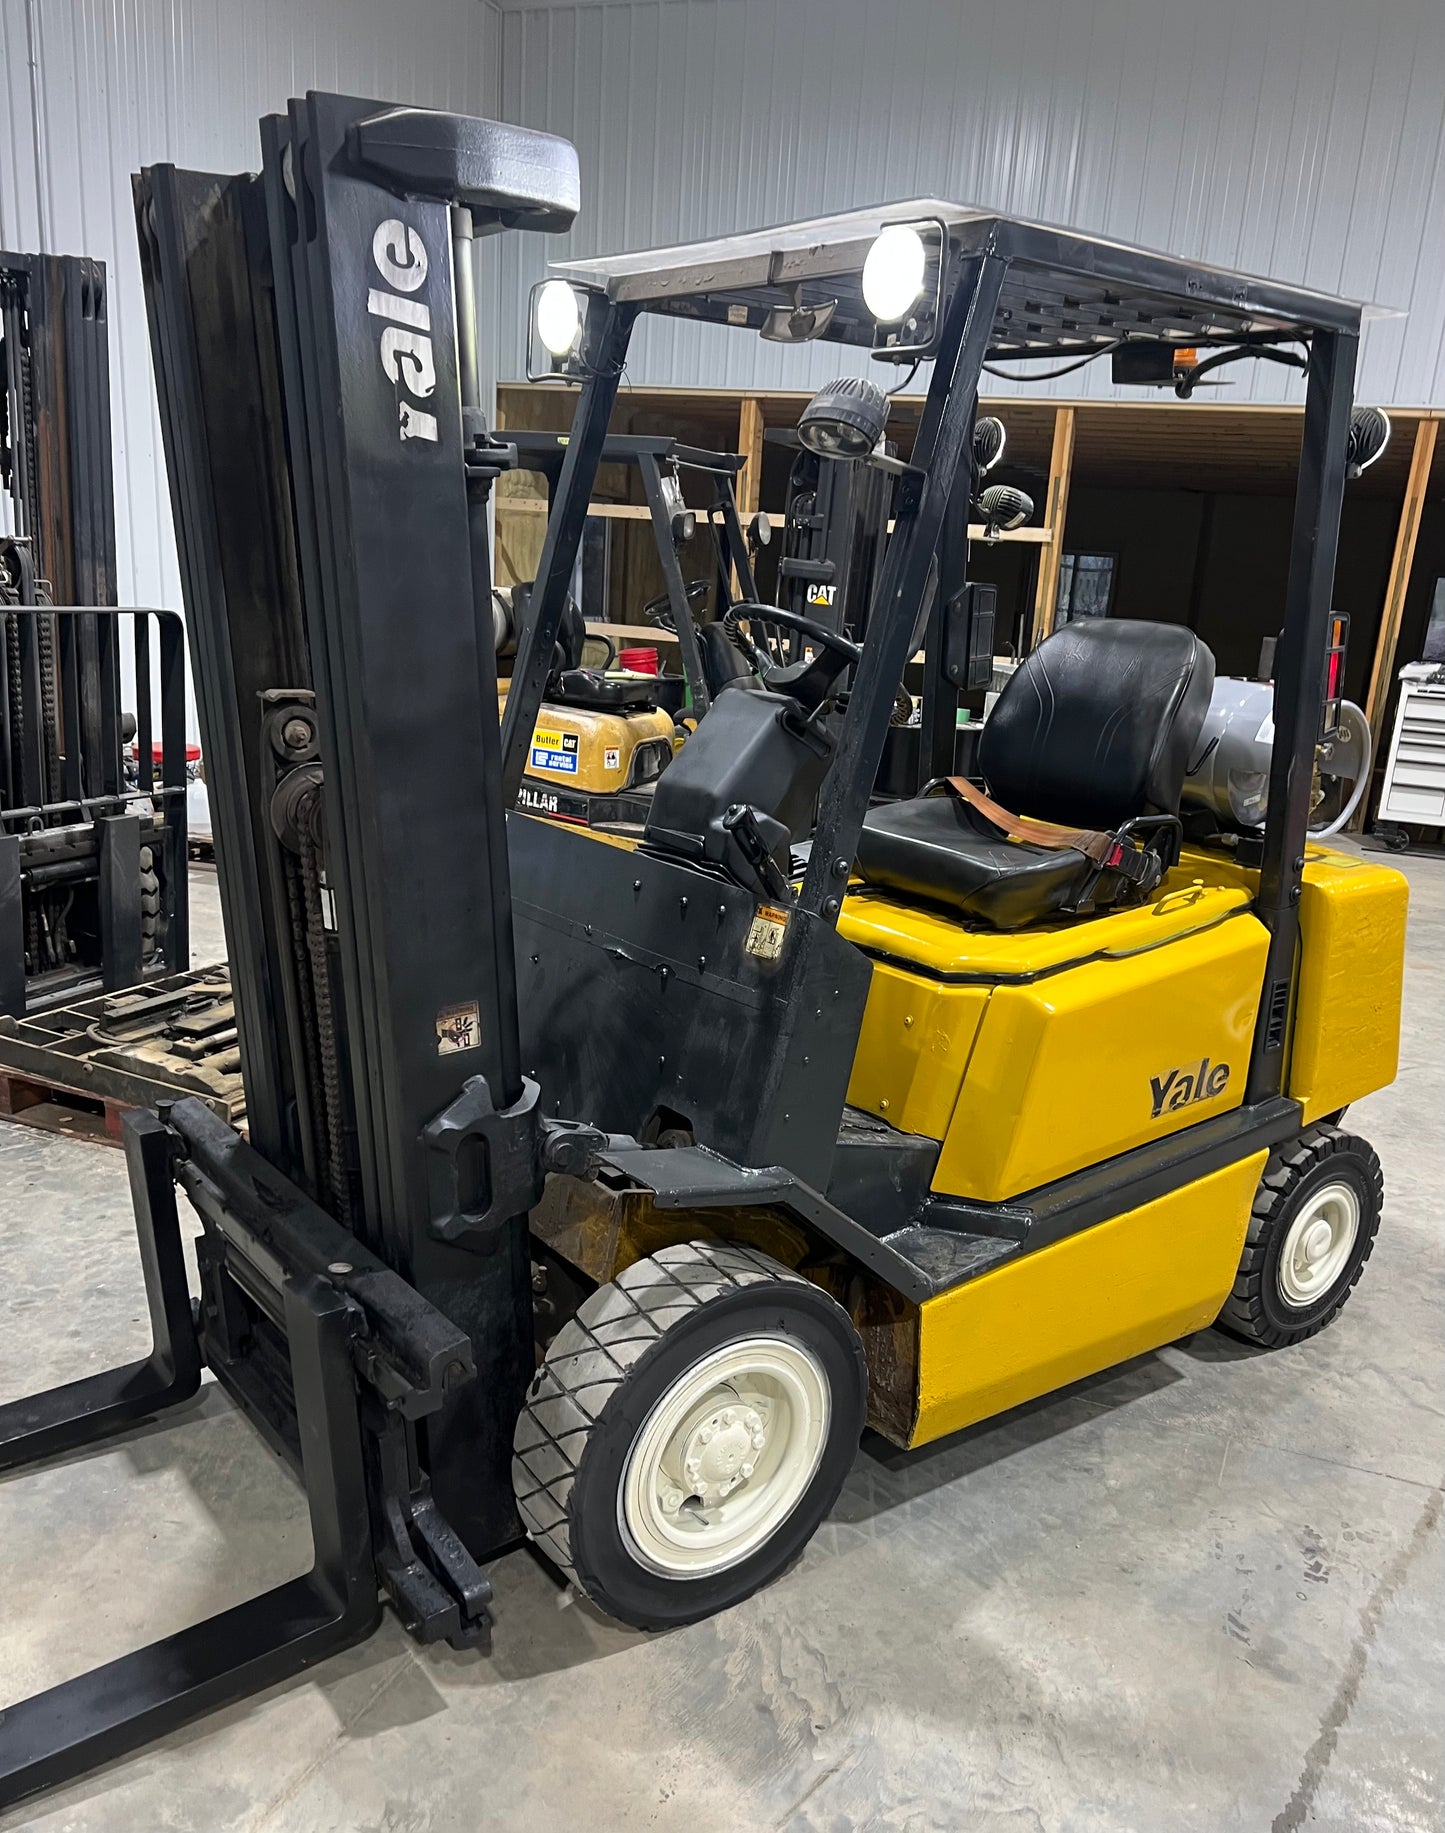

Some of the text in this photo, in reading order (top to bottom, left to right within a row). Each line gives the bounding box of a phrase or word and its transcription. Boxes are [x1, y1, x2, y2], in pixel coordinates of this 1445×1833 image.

[806, 584, 837, 605] CAT
[535, 734, 577, 749] Butler CAT
[548, 760, 574, 769] service
[550, 754, 572, 763] rental
[1149, 1056, 1230, 1119] Yale
